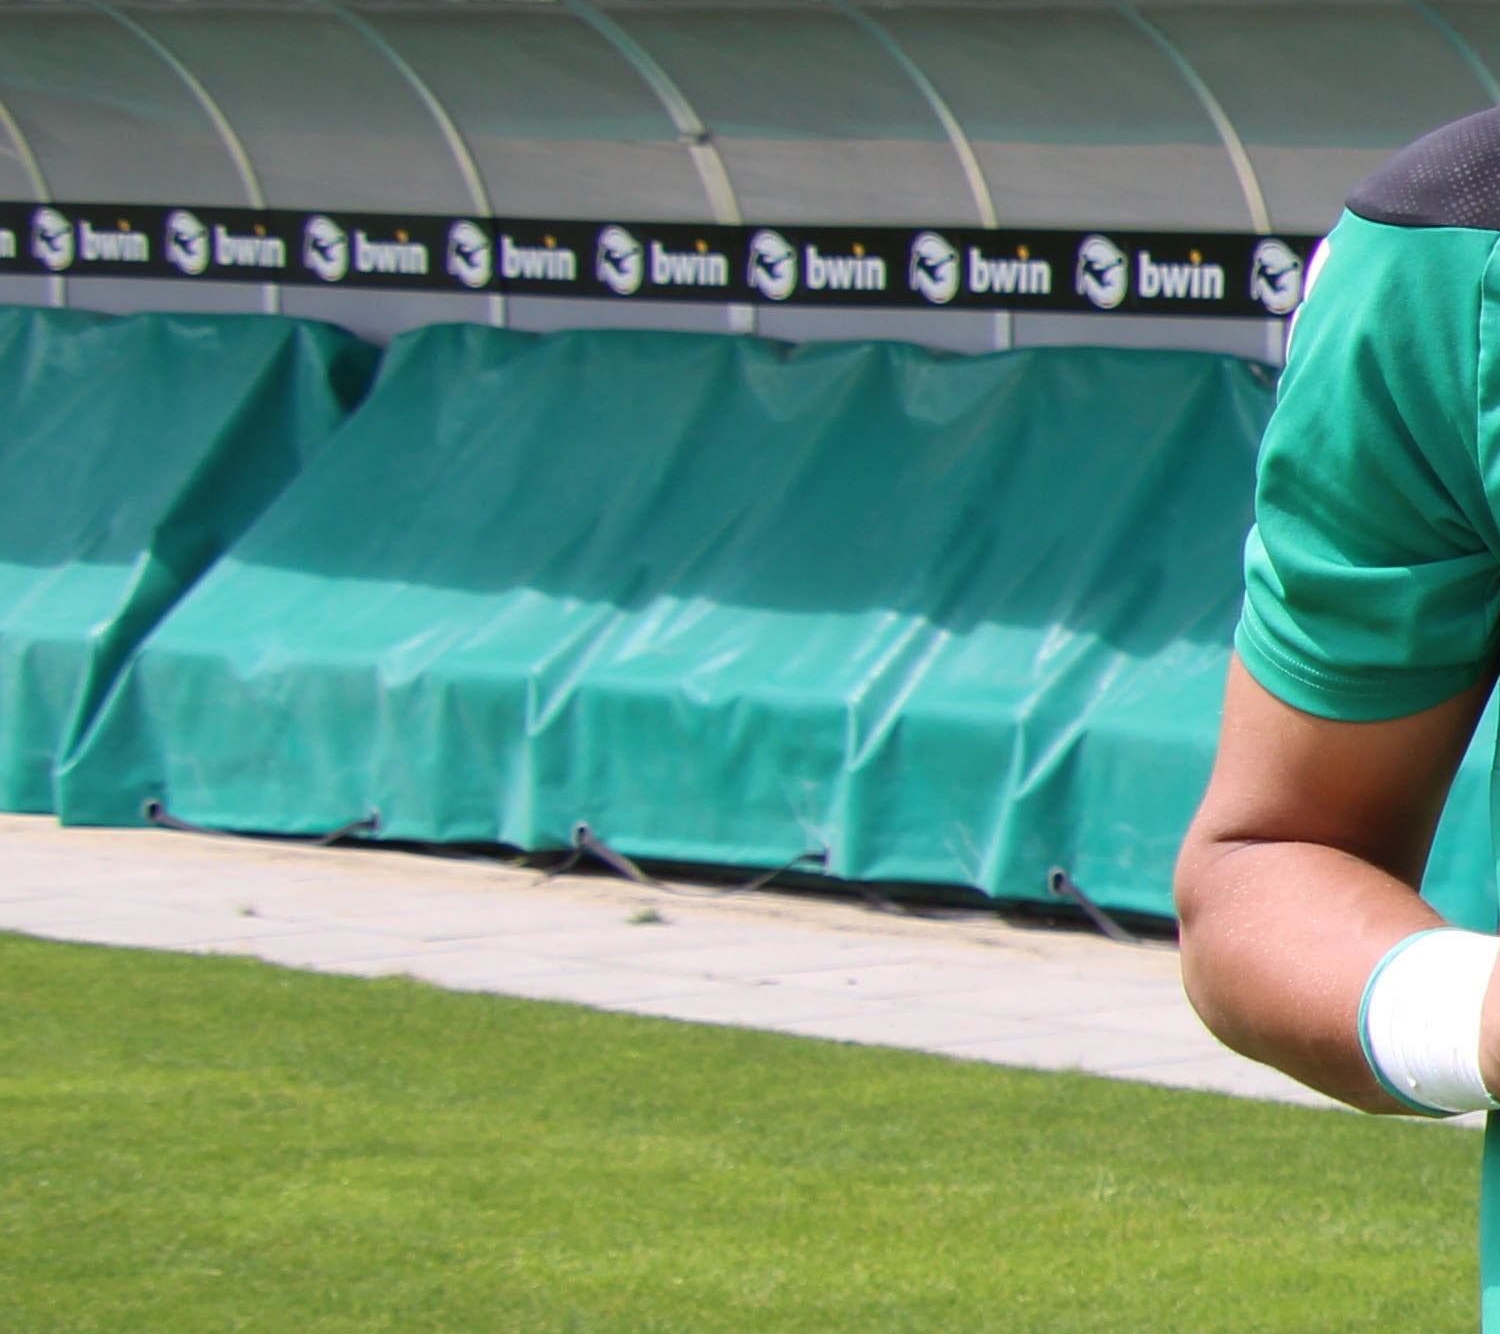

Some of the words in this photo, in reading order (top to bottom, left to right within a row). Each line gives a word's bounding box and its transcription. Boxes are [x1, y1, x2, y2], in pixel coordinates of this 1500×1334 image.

[79, 219, 149, 262] bwin
[214, 224, 286, 267] bwin
[354, 229, 429, 274] bwin
[501, 234, 576, 281] bwin
[650, 239, 728, 286] bwin
[804, 243, 886, 290] bwin
[968, 245, 1051, 294] bwin
[1138, 249, 1225, 299] bwin
